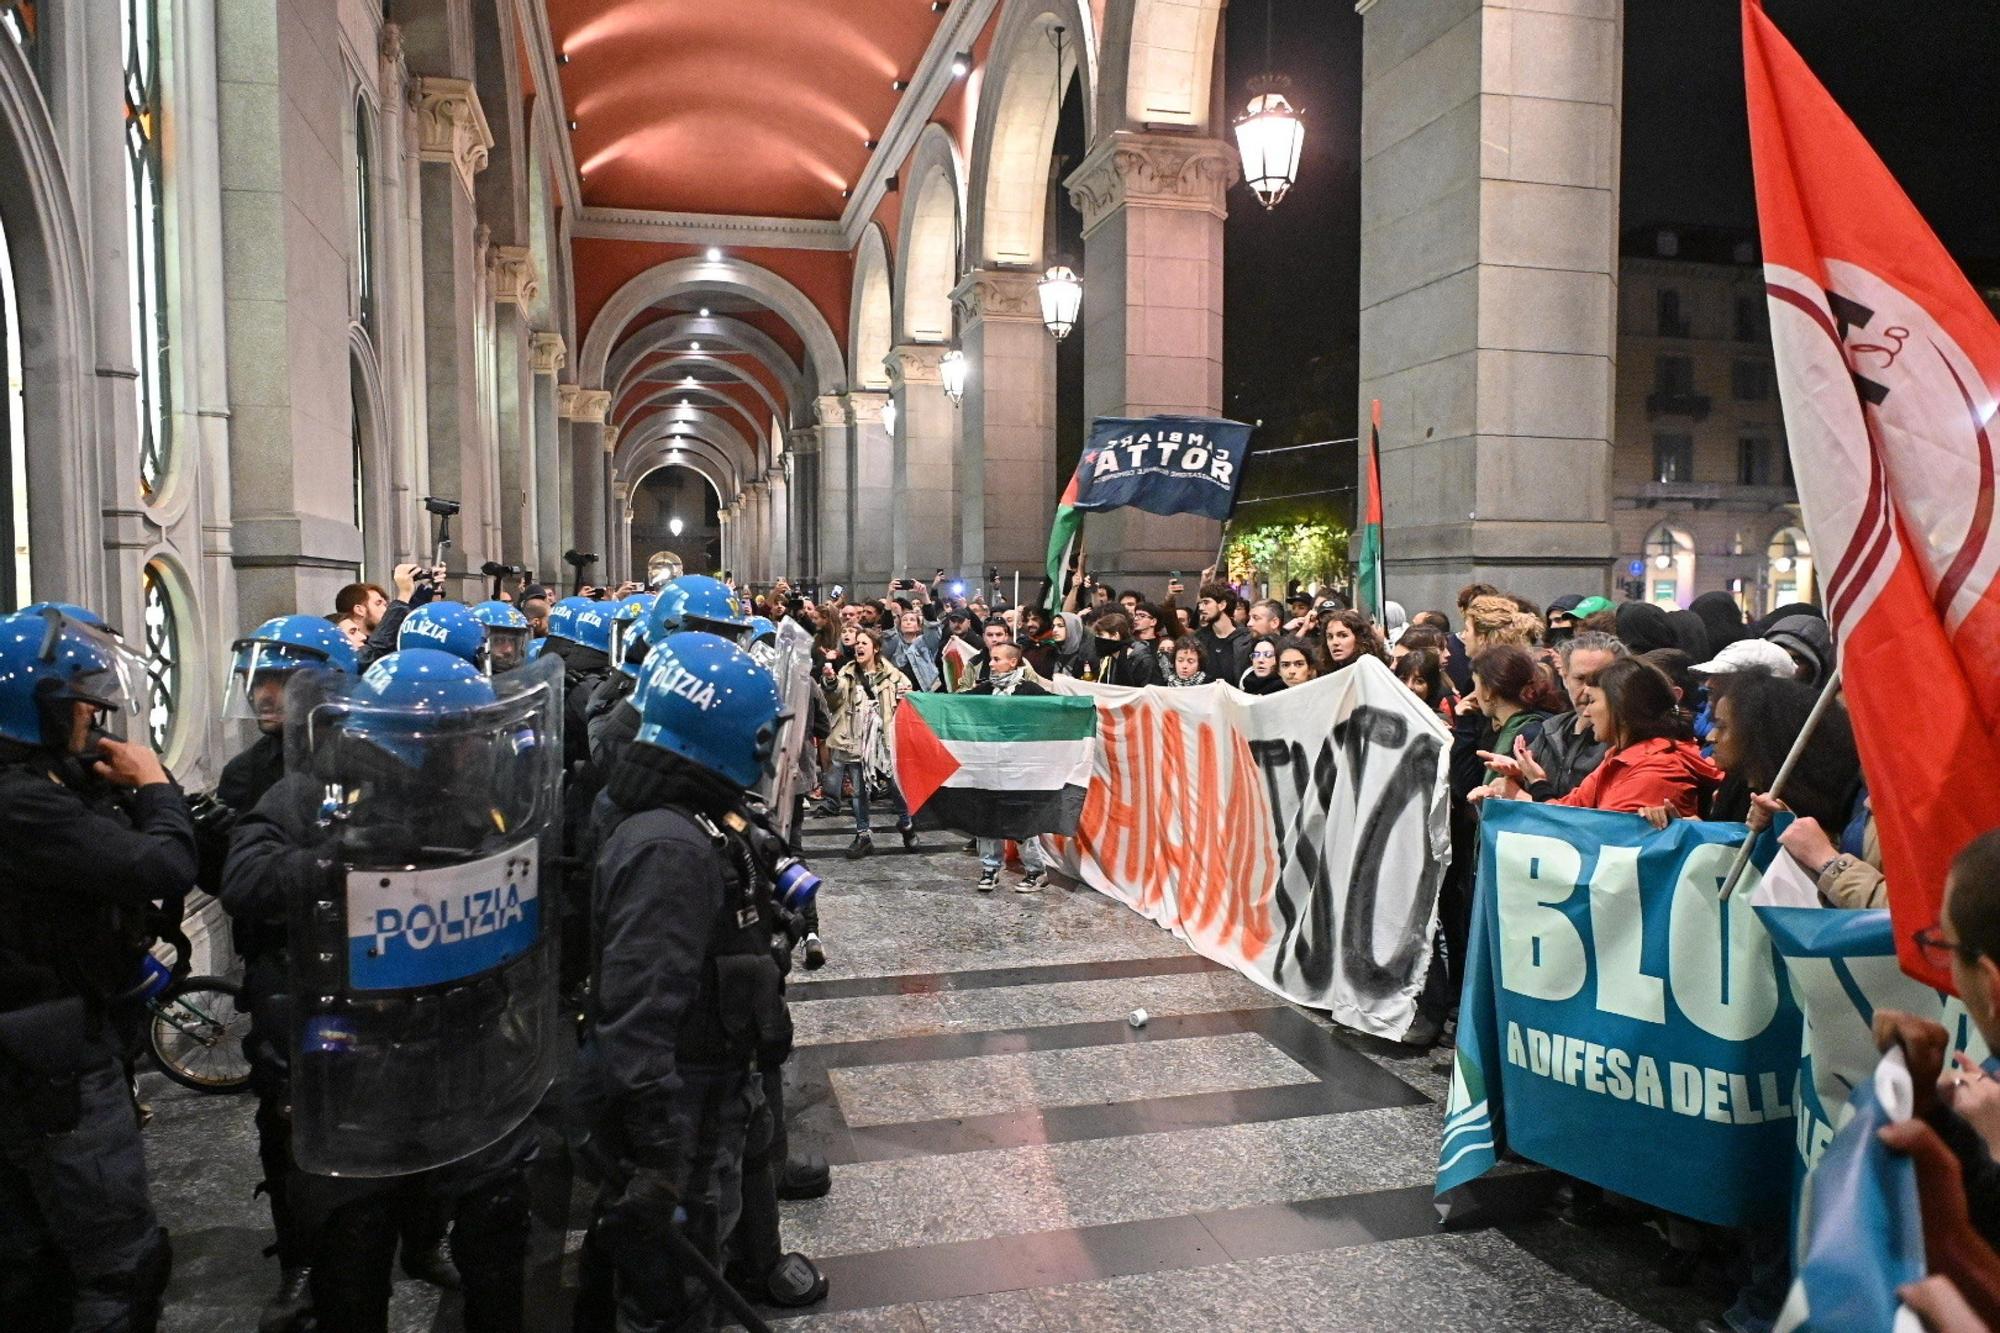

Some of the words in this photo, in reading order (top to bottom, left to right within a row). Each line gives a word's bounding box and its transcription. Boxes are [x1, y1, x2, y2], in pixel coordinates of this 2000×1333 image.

[649, 664, 716, 711] OLIZIA
[375, 882, 524, 956] POLIZIA
[1495, 829, 1779, 1042] BLO
[1506, 1020, 1528, 1069] A
[1526, 1027, 1665, 1109] DIFESA
[1669, 1060, 1800, 1125] DELL
